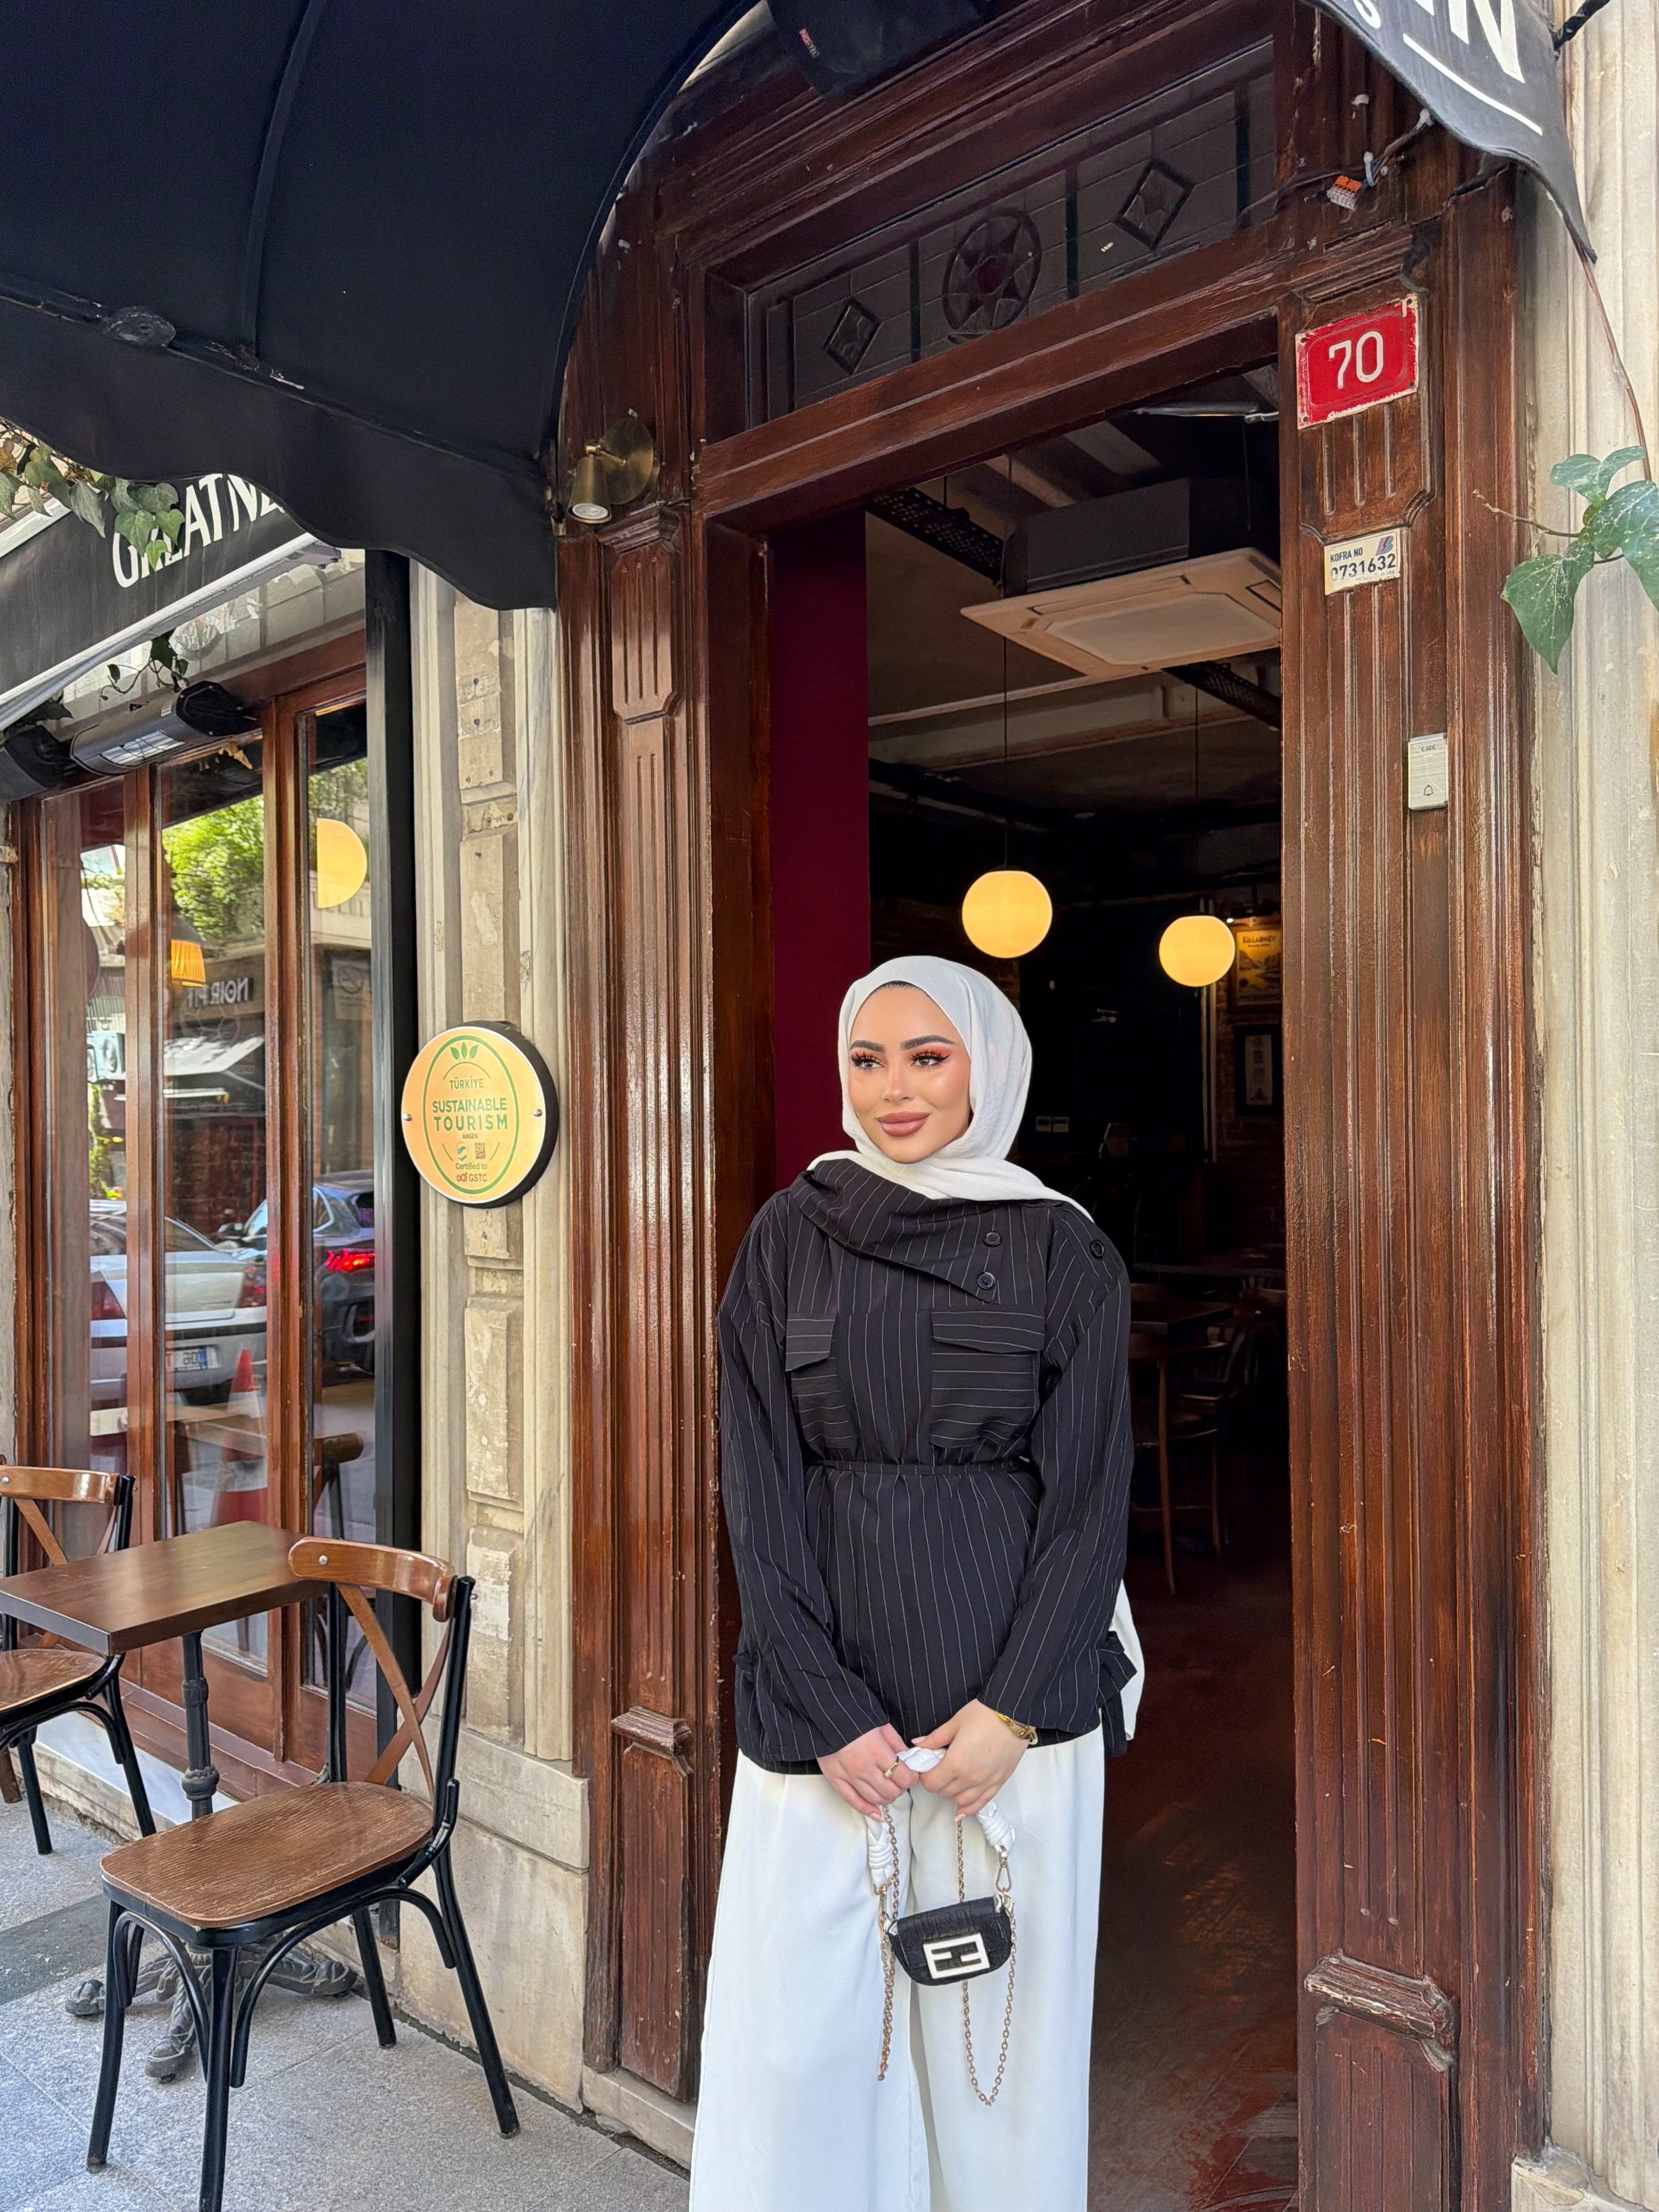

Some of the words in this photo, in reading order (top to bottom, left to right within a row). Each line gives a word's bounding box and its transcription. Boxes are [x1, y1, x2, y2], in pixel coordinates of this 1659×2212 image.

[1328, 330, 1384, 390] 70
[1330, 550, 1352, 563] KOFRA
[1353, 547, 1363, 557] NO
[1331, 553, 1396, 581] 0731632
[449, 1076, 484, 1090] TÜRKİYE
[432, 1097, 507, 1113] SUSTAINABLE
[433, 1114, 508, 1131] TOURISM
[469, 1173, 487, 1182] GSTC
